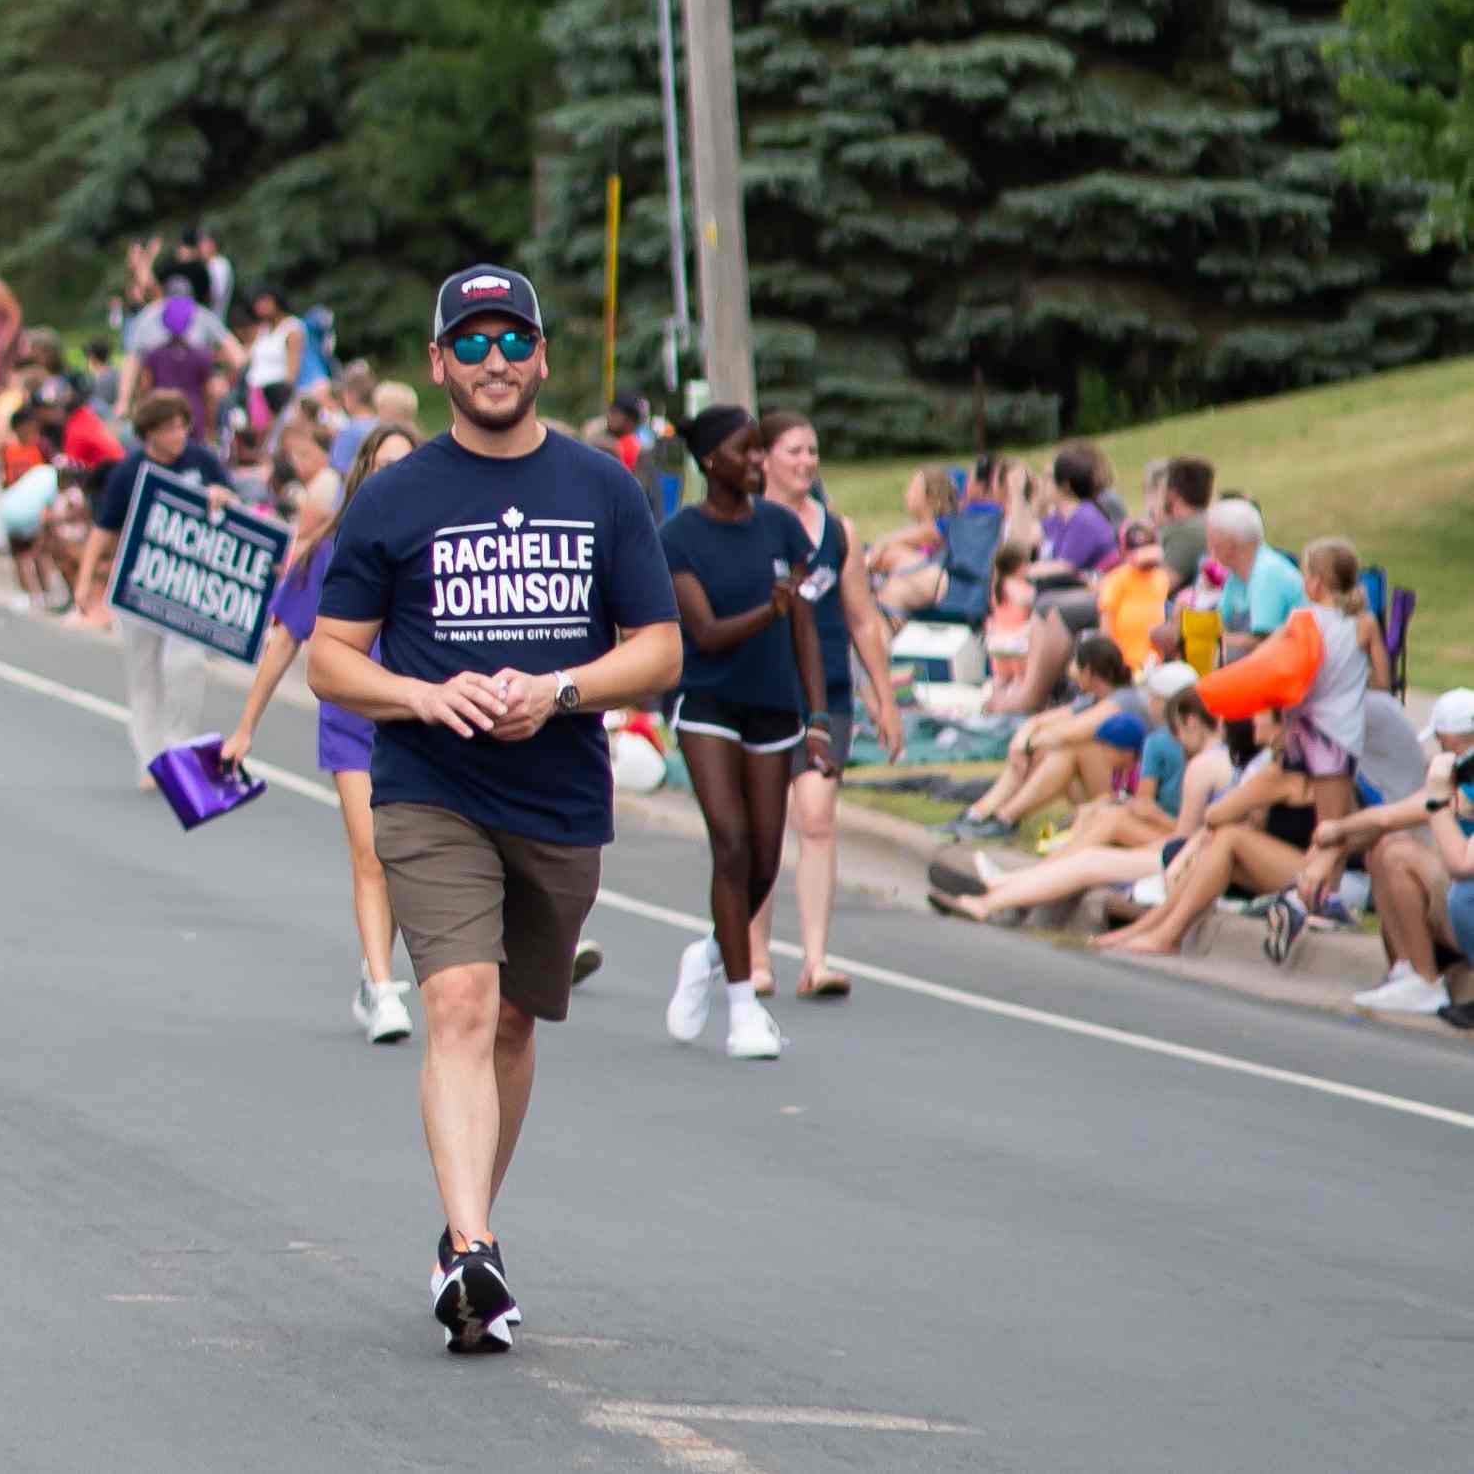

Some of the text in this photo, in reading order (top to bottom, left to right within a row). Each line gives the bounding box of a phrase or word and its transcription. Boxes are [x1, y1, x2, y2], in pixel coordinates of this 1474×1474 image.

[144, 503, 273, 590] RACHELLE
[432, 533, 595, 575] RACHELLE
[131, 541, 263, 632] JOHNSON
[432, 573, 593, 617] JOHNSON
[450, 630, 484, 642] MAPLE
[487, 629, 524, 641] GROVE
[527, 628, 551, 640] CITY
